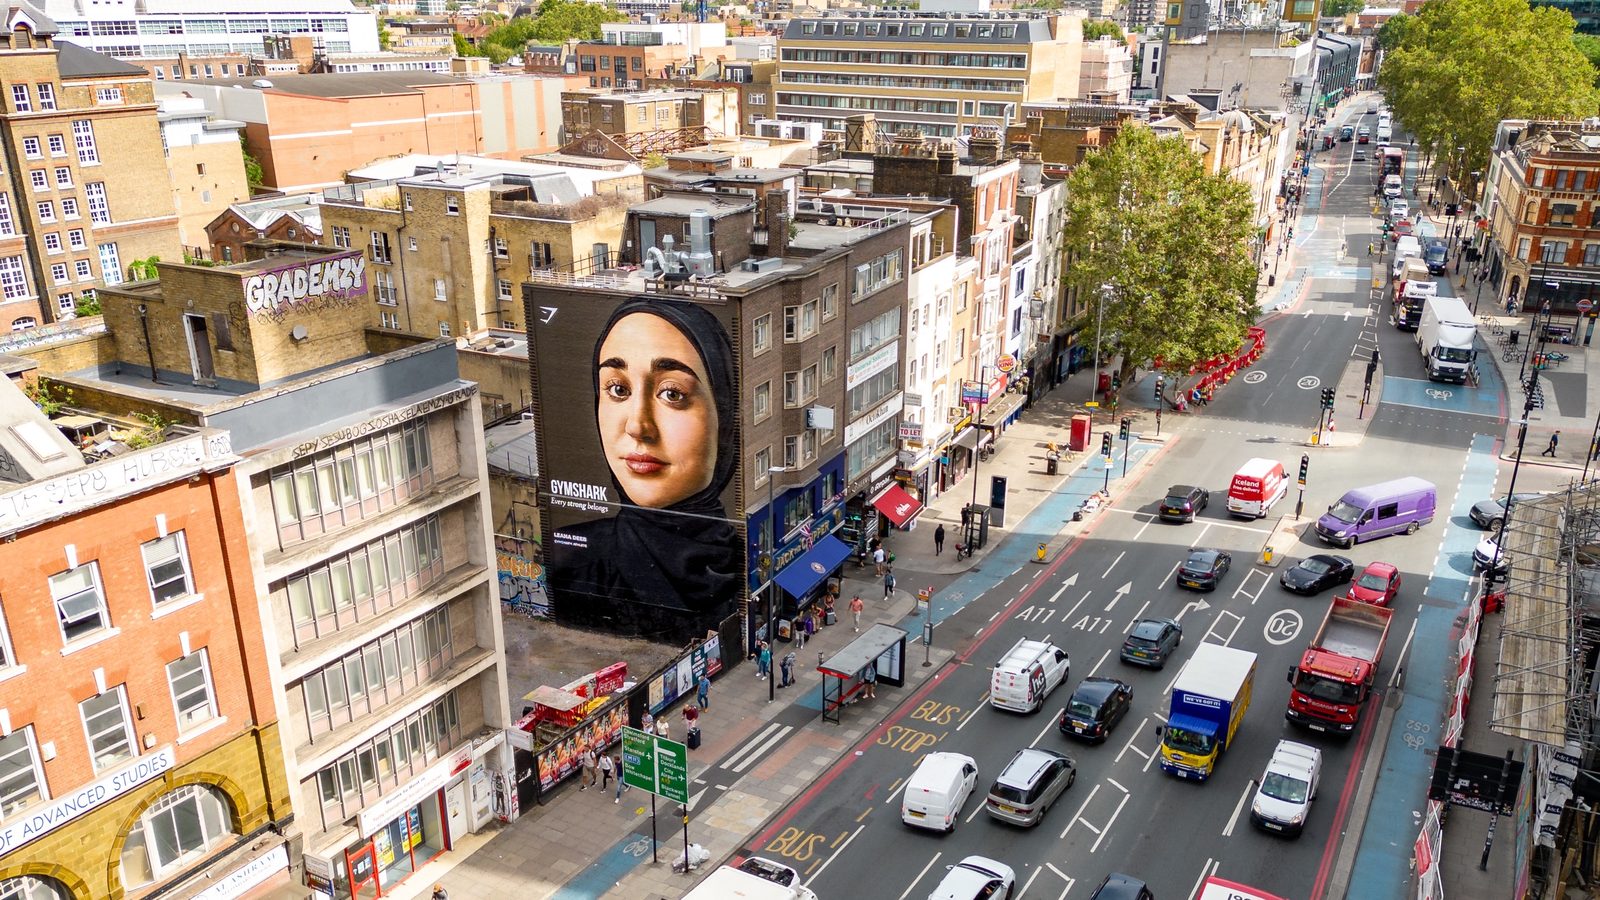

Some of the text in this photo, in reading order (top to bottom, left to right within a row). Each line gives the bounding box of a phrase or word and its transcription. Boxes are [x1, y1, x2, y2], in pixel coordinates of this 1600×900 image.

[245, 255, 365, 313] GRADEMZY
[1247, 373, 1264, 381] 20
[1300, 378, 1317, 386] 20
[900, 428, 909, 436] TO
[550, 479, 608, 502] GYMSHARK
[1235, 478, 1260, 487] Iceland
[550, 497, 609, 513] Every strong belongs
[1015, 605, 1056, 624] A11
[1072, 615, 1113, 634] A11
[1269, 617, 1298, 636] 20
[910, 700, 960, 725] BUS
[1406, 719, 1430, 733] CS2
[876, 725, 937, 753] STOP
[23, 785, 105, 838] ADVANCED
[112, 752, 168, 791] STUDIES
[766, 826, 825, 861] BUS
